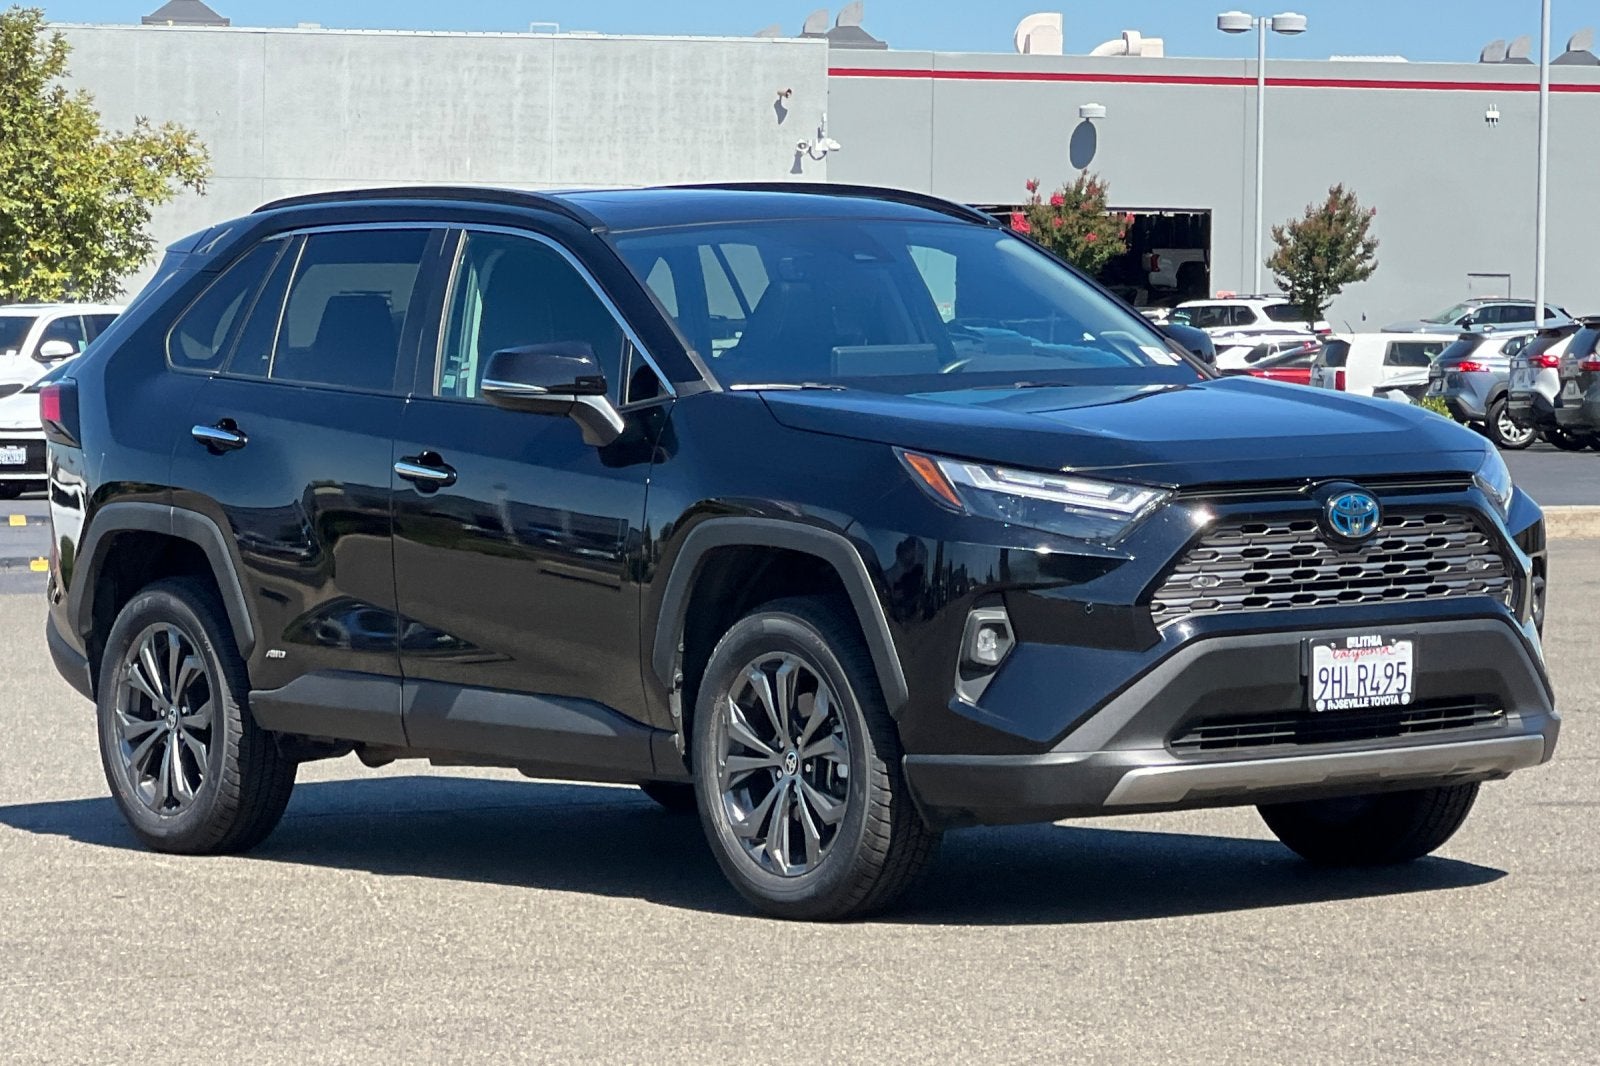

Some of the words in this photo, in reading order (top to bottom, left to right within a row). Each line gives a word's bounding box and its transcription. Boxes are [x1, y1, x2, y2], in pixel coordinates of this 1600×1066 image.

[1318, 662, 1406, 700] 9HLR495
[1327, 696, 1369, 710] ROSEVILLE
[1370, 694, 1400, 706] TOYOTA
